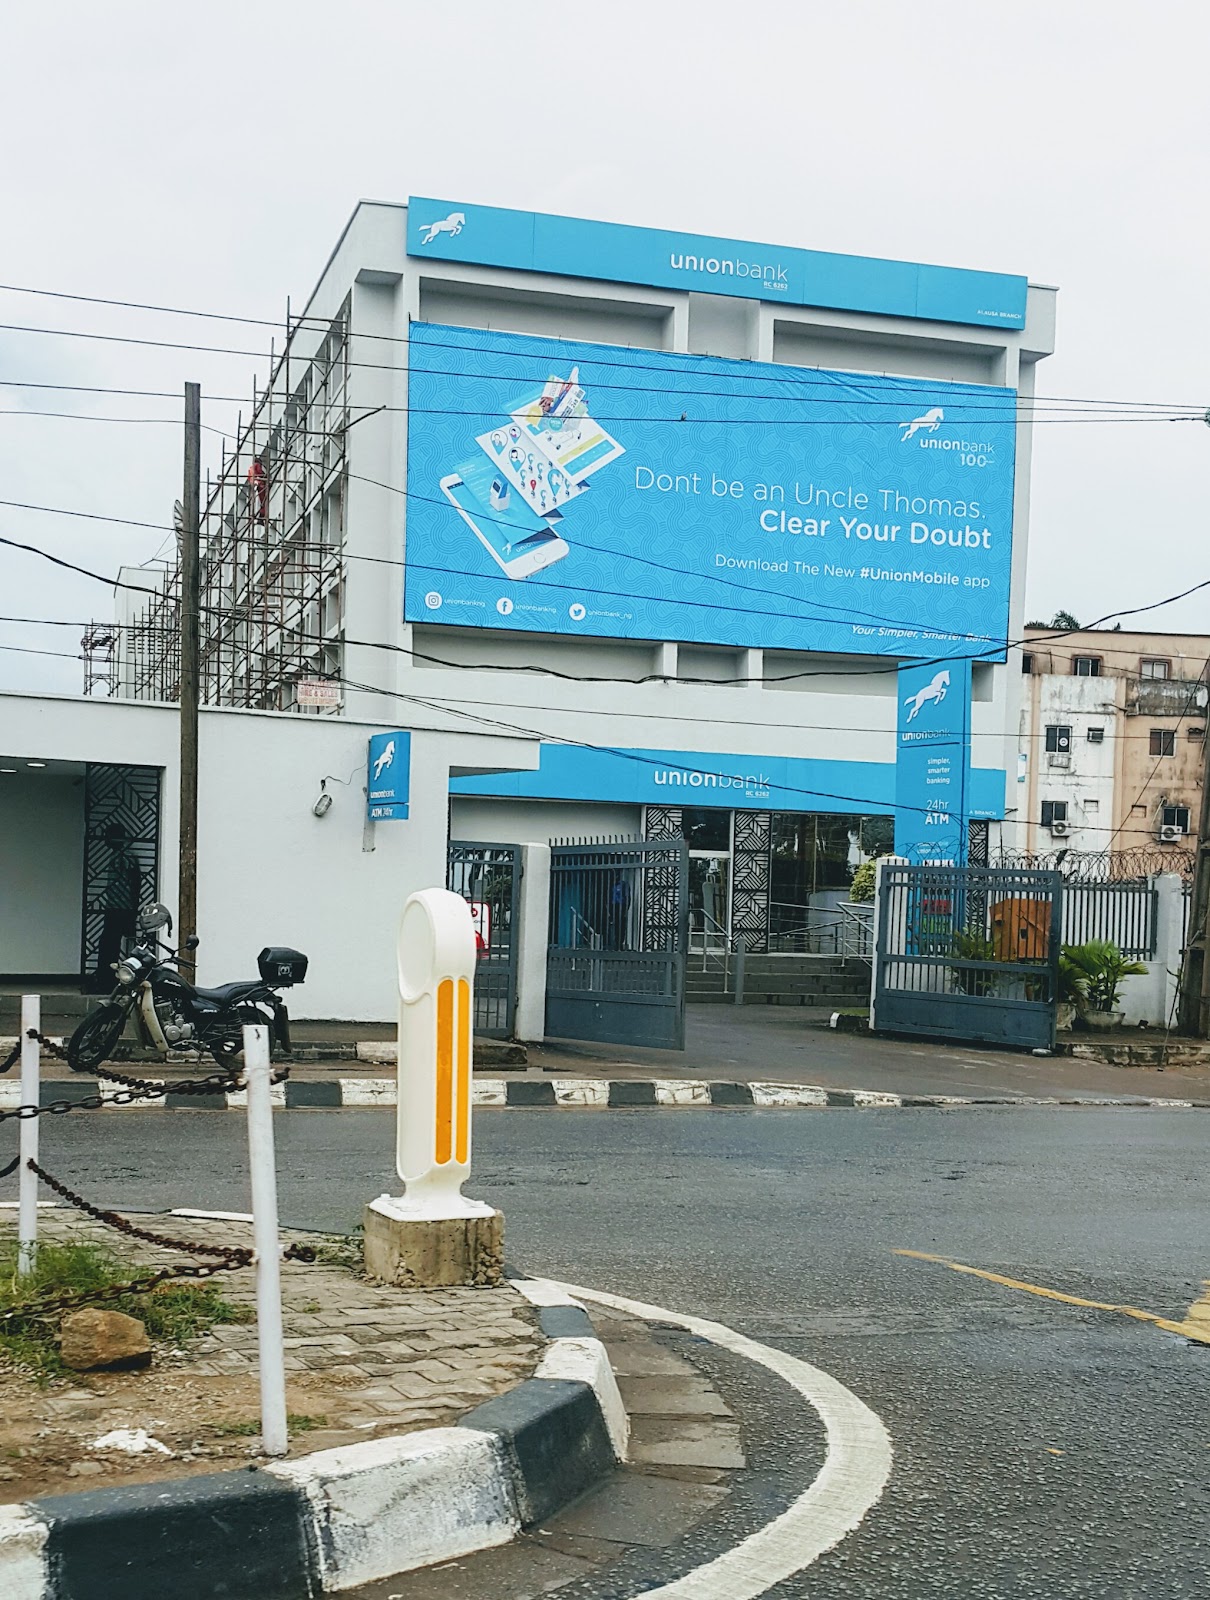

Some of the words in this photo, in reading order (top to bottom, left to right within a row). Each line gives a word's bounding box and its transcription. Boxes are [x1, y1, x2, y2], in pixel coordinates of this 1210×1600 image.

[670, 252, 789, 283] unionbank
[999, 311, 1022, 320] BRANCH
[920, 438, 995, 454] unionbank
[710, 472, 745, 499] be
[752, 482, 785, 504] an
[794, 482, 869, 511] Uncle
[878, 488, 987, 520] Thomas.
[759, 508, 831, 538] Clear
[838, 515, 902, 543] Your
[909, 520, 992, 550] Doubt
[715, 553, 789, 574] Download
[793, 561, 820, 577] The
[823, 563, 856, 579] New
[859, 566, 960, 587] #UnionMobile
[963, 575, 991, 590] app
[851, 624, 875, 636] Your
[654, 770, 770, 790] unionbank
[926, 776, 951, 785] banking
[926, 799, 950, 811] 24hr
[371, 808, 383, 818] ATM
[924, 812, 950, 825] ATM
